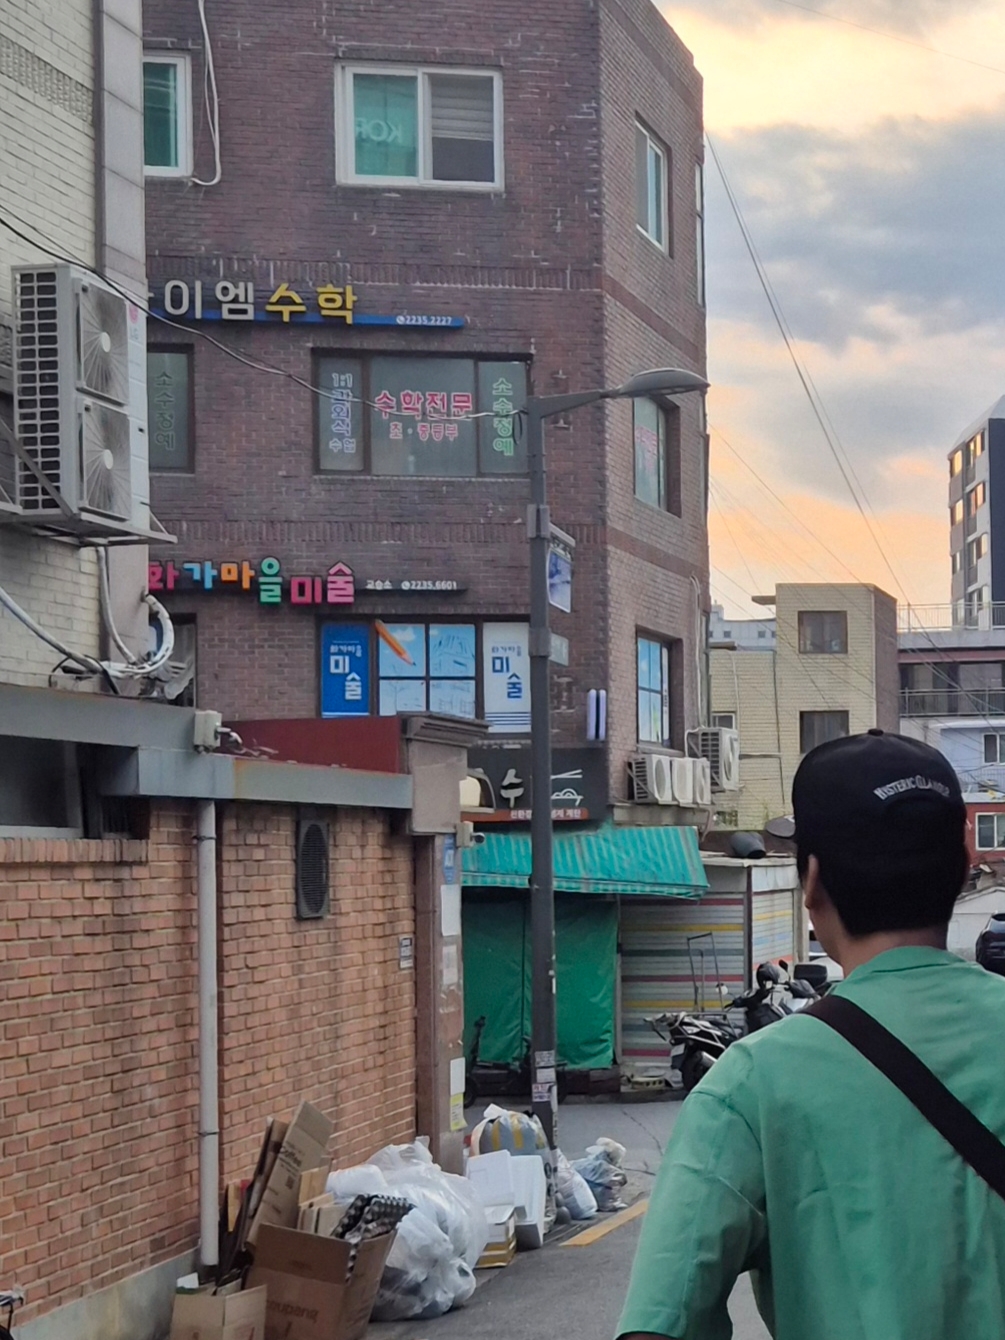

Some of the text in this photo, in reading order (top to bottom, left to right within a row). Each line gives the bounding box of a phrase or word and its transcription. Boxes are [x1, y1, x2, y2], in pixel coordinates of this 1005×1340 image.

[332, 373, 353, 388] 1:1
[155, 371, 175, 449] 소수정예
[375, 389, 473, 420] 수학전문
[493, 377, 514, 456] 소수정예
[329, 438, 357, 453] 수업
